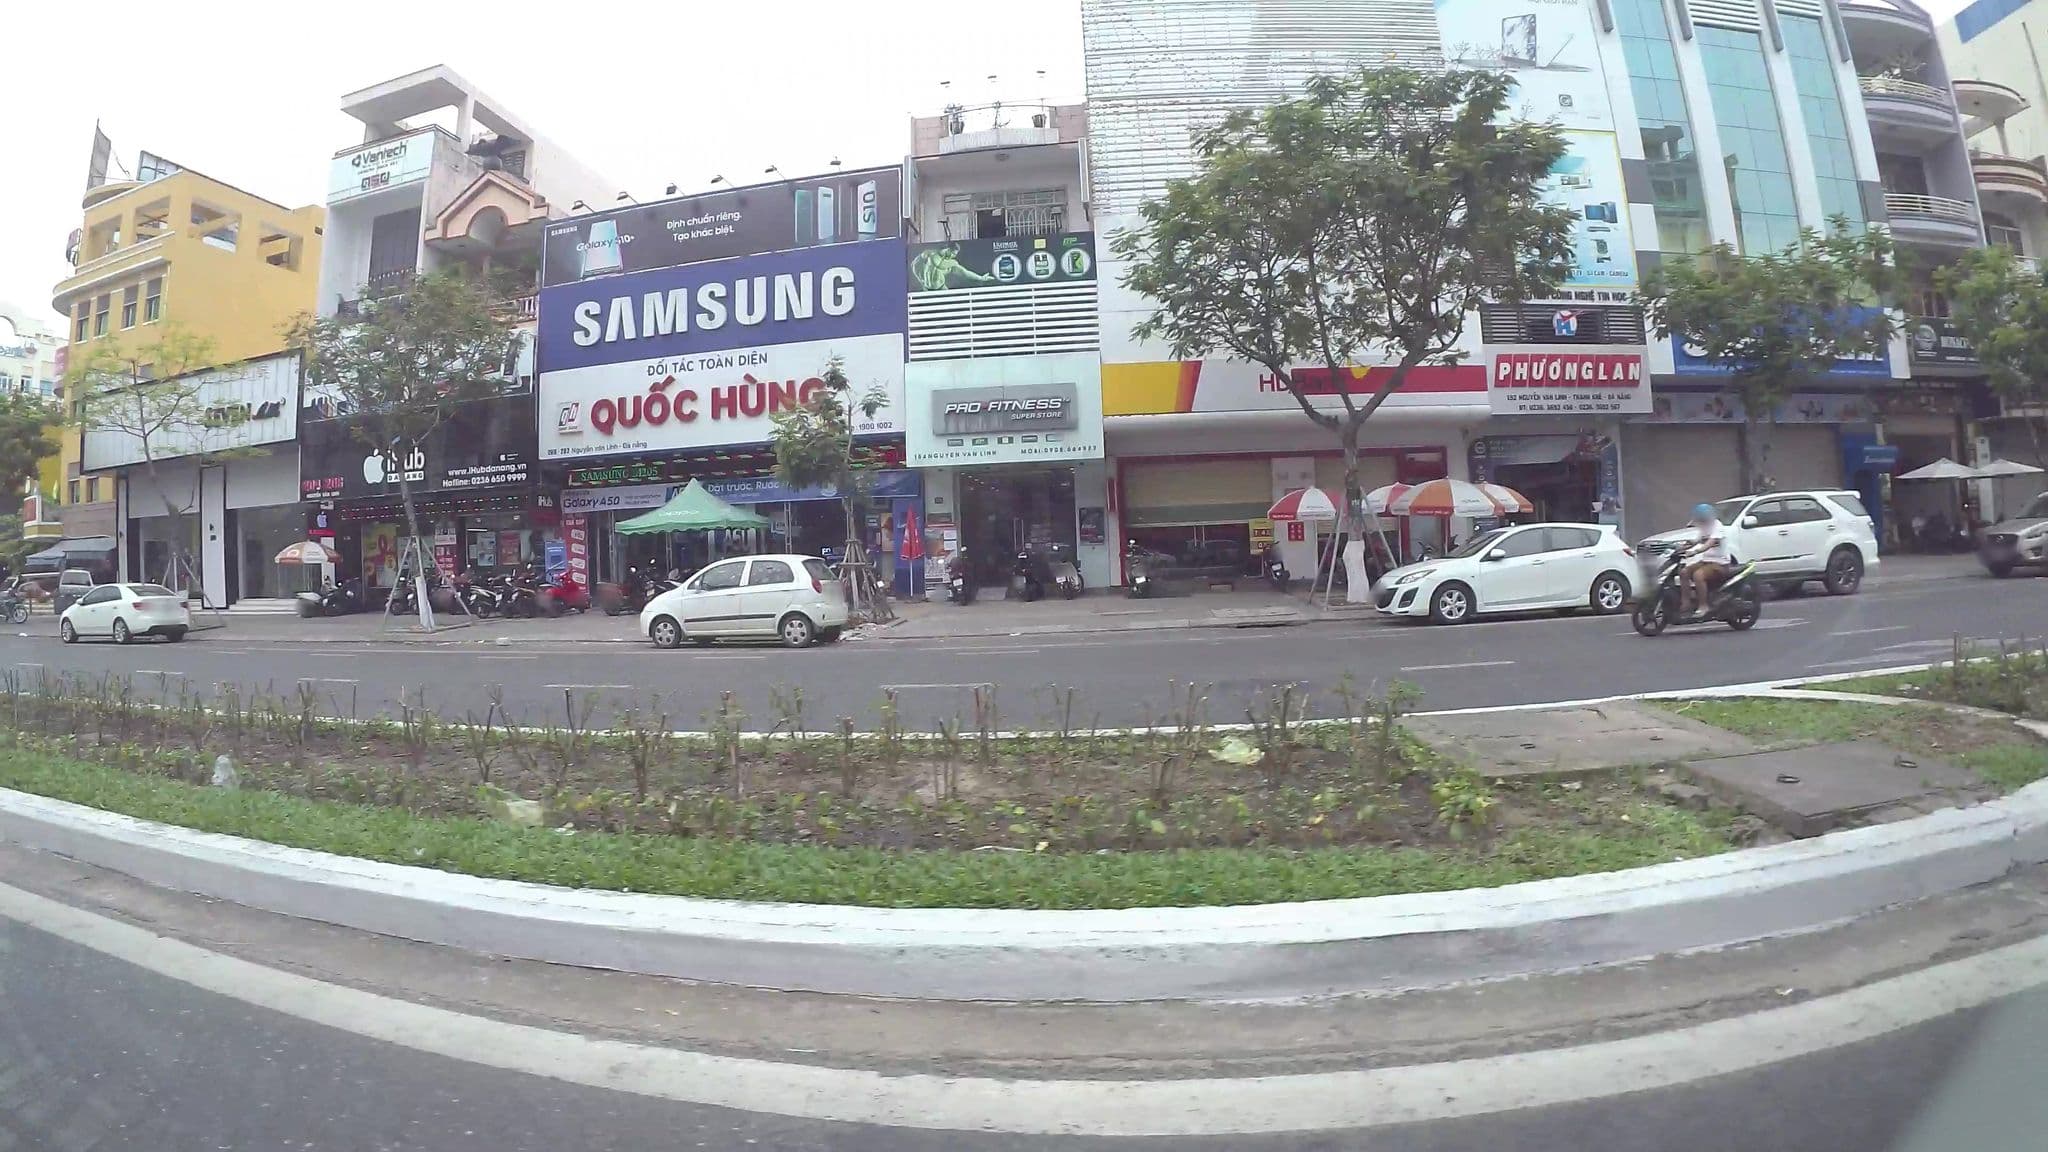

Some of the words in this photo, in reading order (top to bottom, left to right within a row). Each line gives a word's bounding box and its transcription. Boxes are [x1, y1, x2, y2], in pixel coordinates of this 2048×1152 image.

[576, 237, 613, 252] Galaxy
[573, 267, 856, 347] SAMSUNG
[647, 358, 669, 376] ĐỐI
[672, 357, 695, 374] TÁC
[698, 353, 734, 371] TOÀN
[738, 351, 768, 368] DIỆN
[590, 375, 699, 436] QUỐC
[710, 373, 828, 421] HÙNG
[944, 402, 981, 415] PRO
[987, 398, 1062, 412] FITNESS
[858, 422, 875, 431] 1900
[876, 421, 893, 430] 1002
[387, 471, 424, 482] DAANG
[507, 472, 527, 482] 9999
[563, 496, 600, 509] Galaxy
[600, 495, 621, 506] A50
